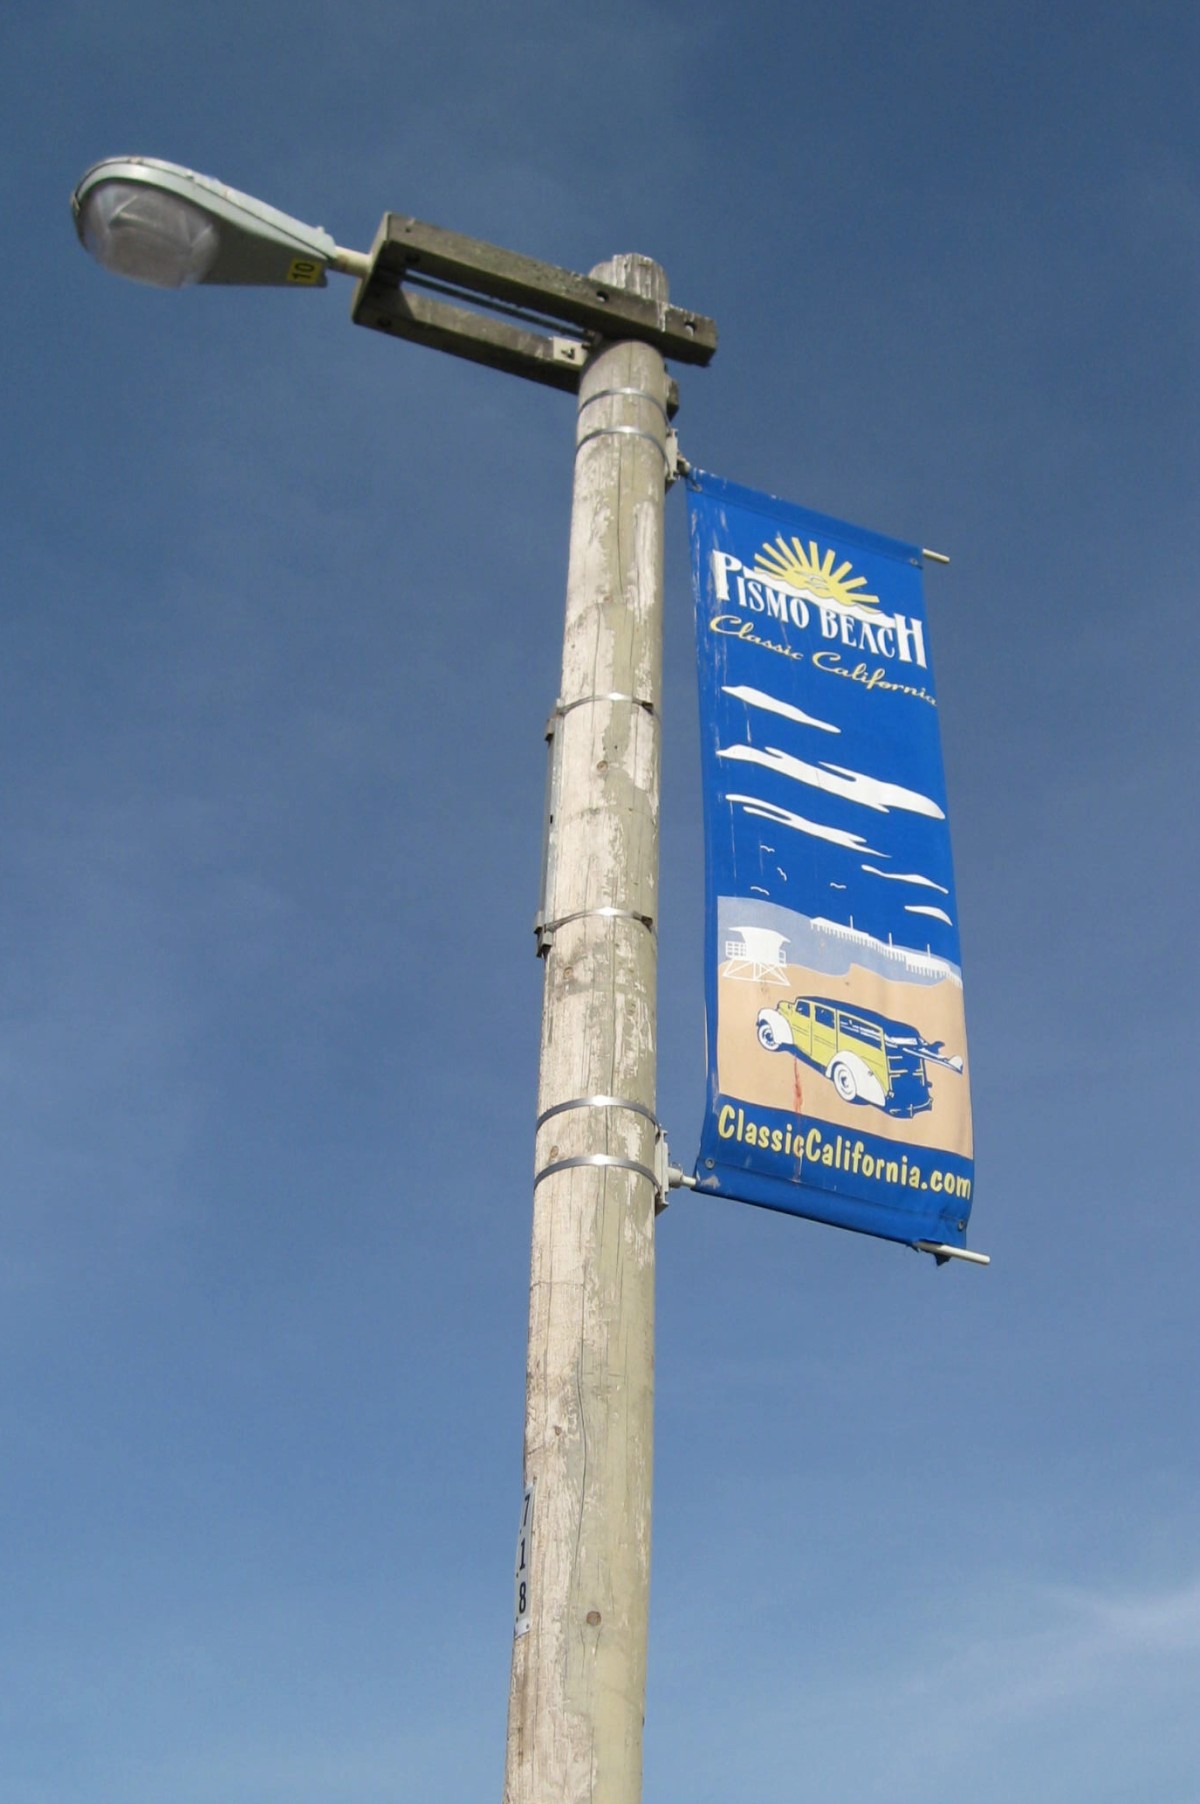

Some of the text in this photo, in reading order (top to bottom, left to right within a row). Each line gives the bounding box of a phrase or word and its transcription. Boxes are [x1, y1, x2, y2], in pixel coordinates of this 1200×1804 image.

[292, 262, 315, 279] 10
[712, 549, 928, 669] PISMO BEACH
[709, 614, 937, 707] Classic California
[718, 1104, 971, 1200] ClassicCalifornia.com
